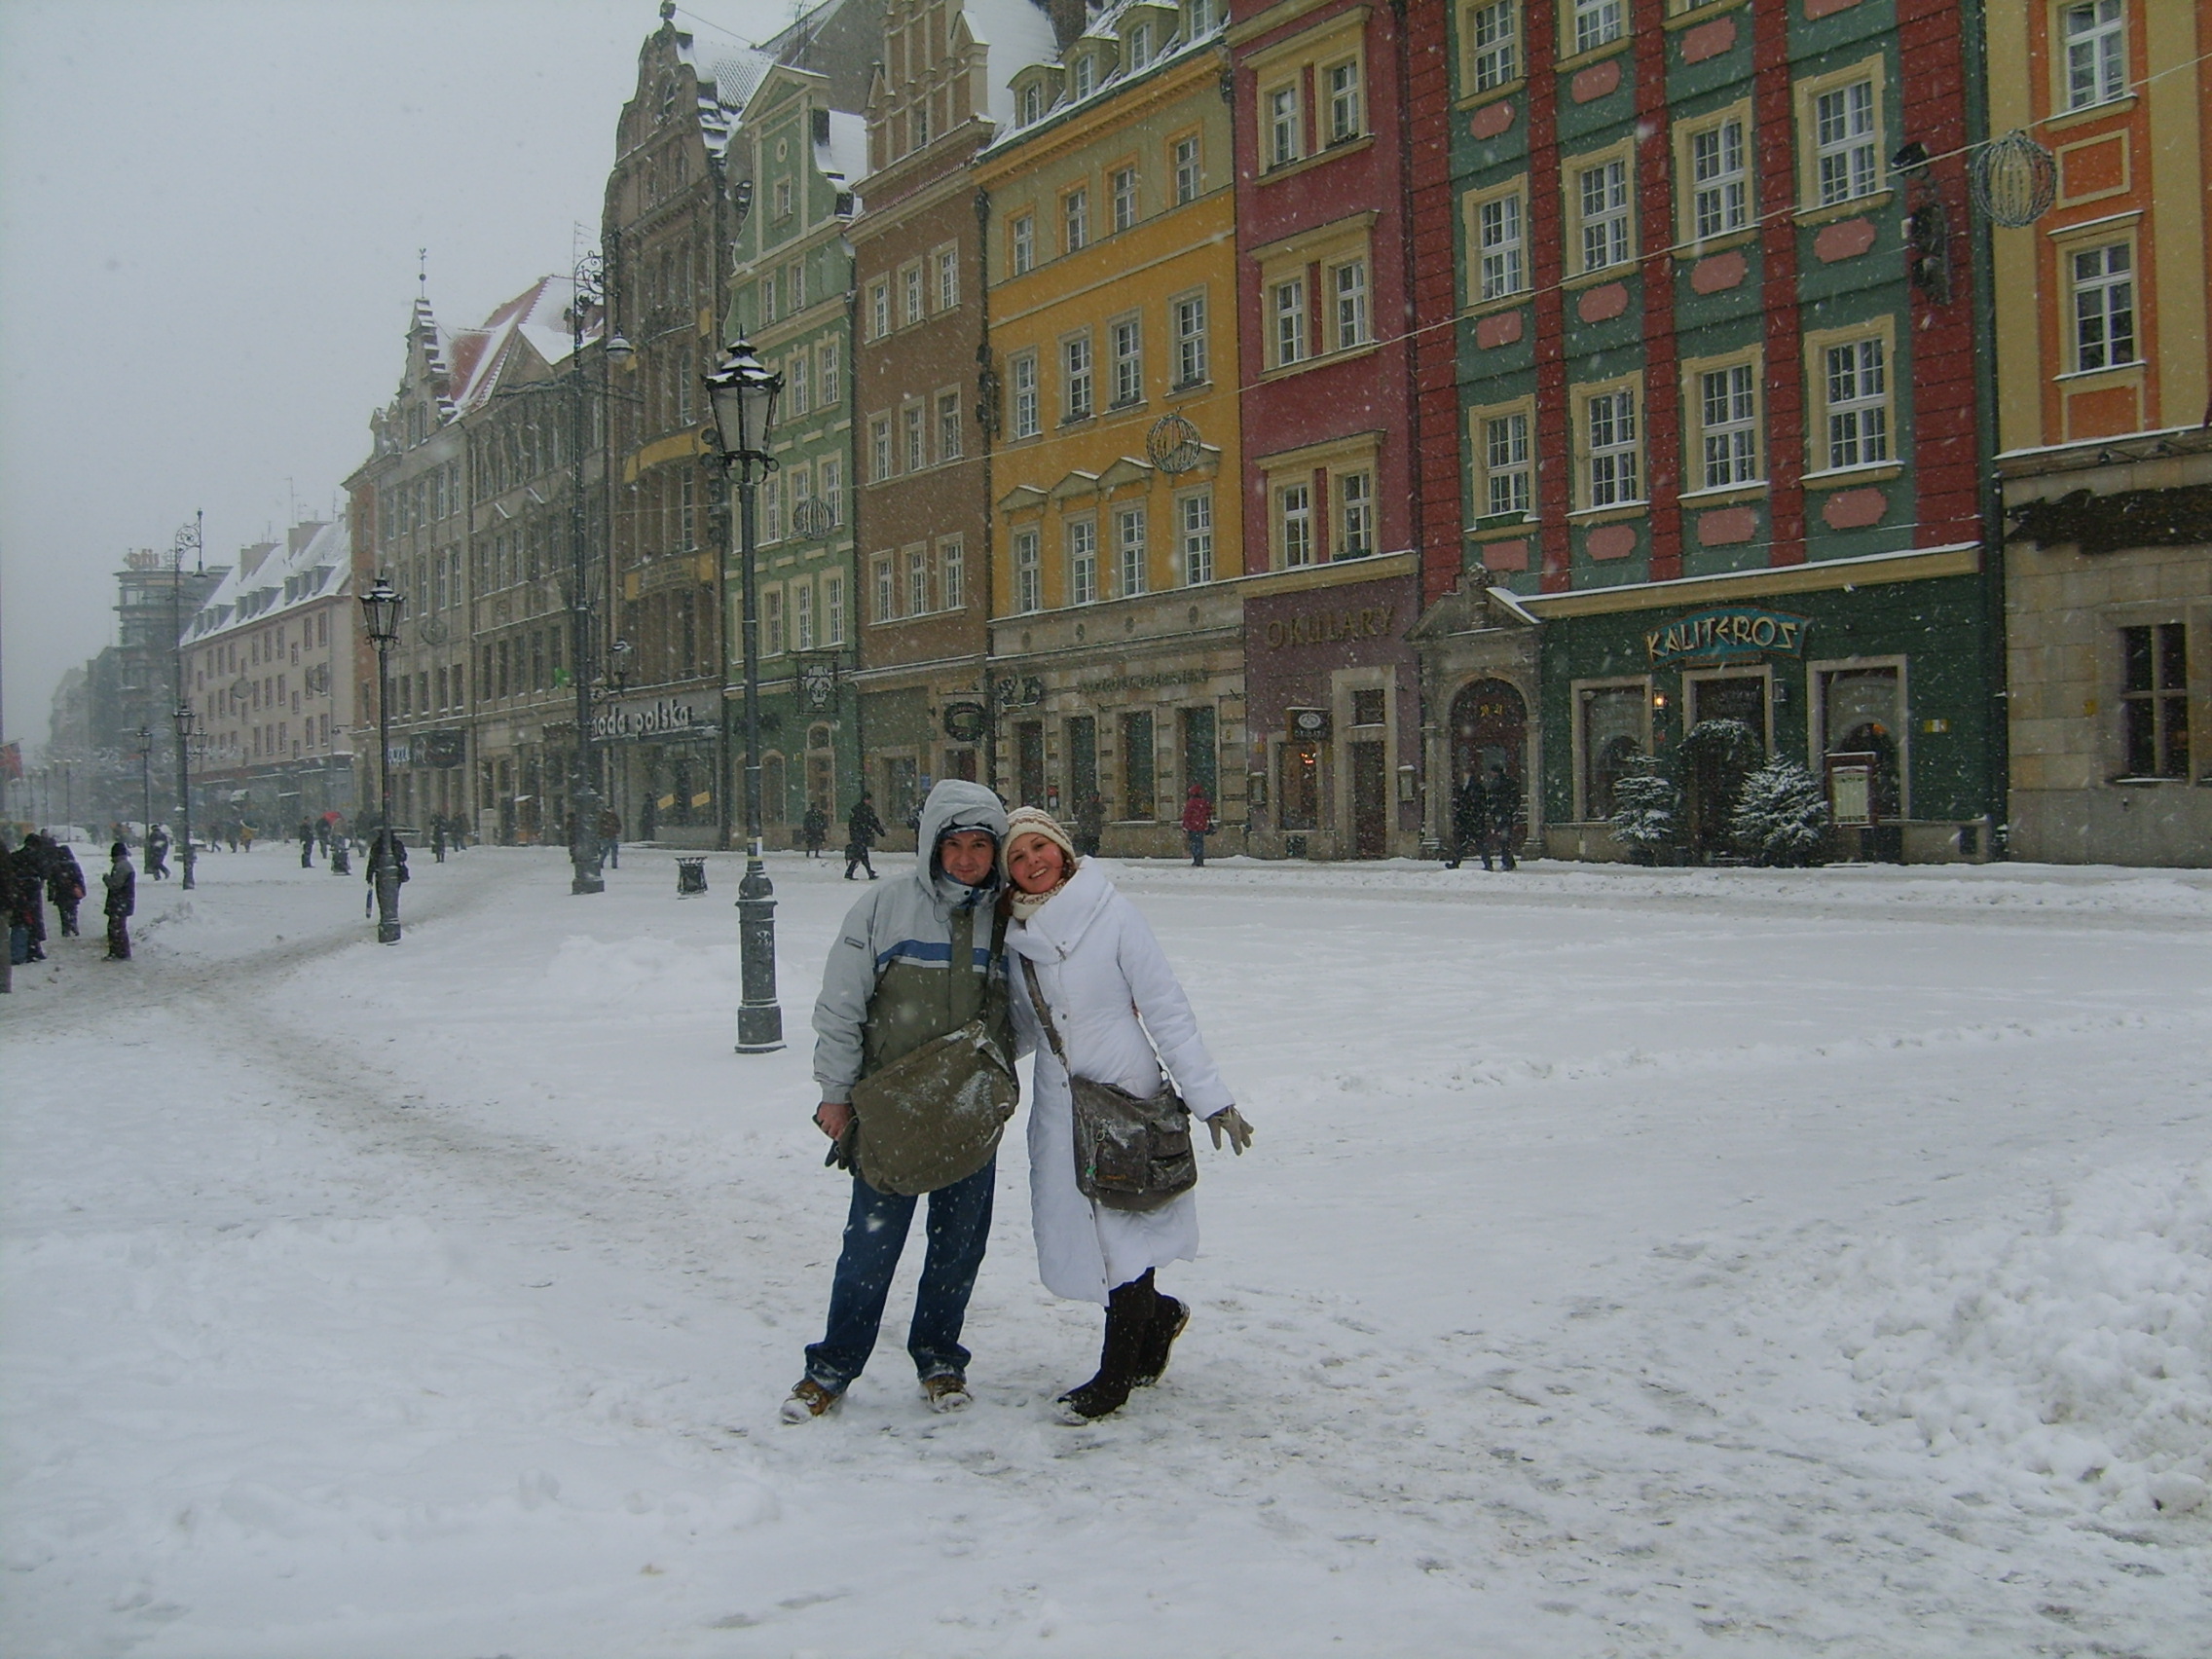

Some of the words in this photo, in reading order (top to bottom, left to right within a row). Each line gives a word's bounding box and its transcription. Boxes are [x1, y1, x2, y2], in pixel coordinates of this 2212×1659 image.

[1267, 606, 1395, 647] OKULARY
[1646, 615, 1795, 660] KALITEROS
[635, 699, 689, 741] polska
